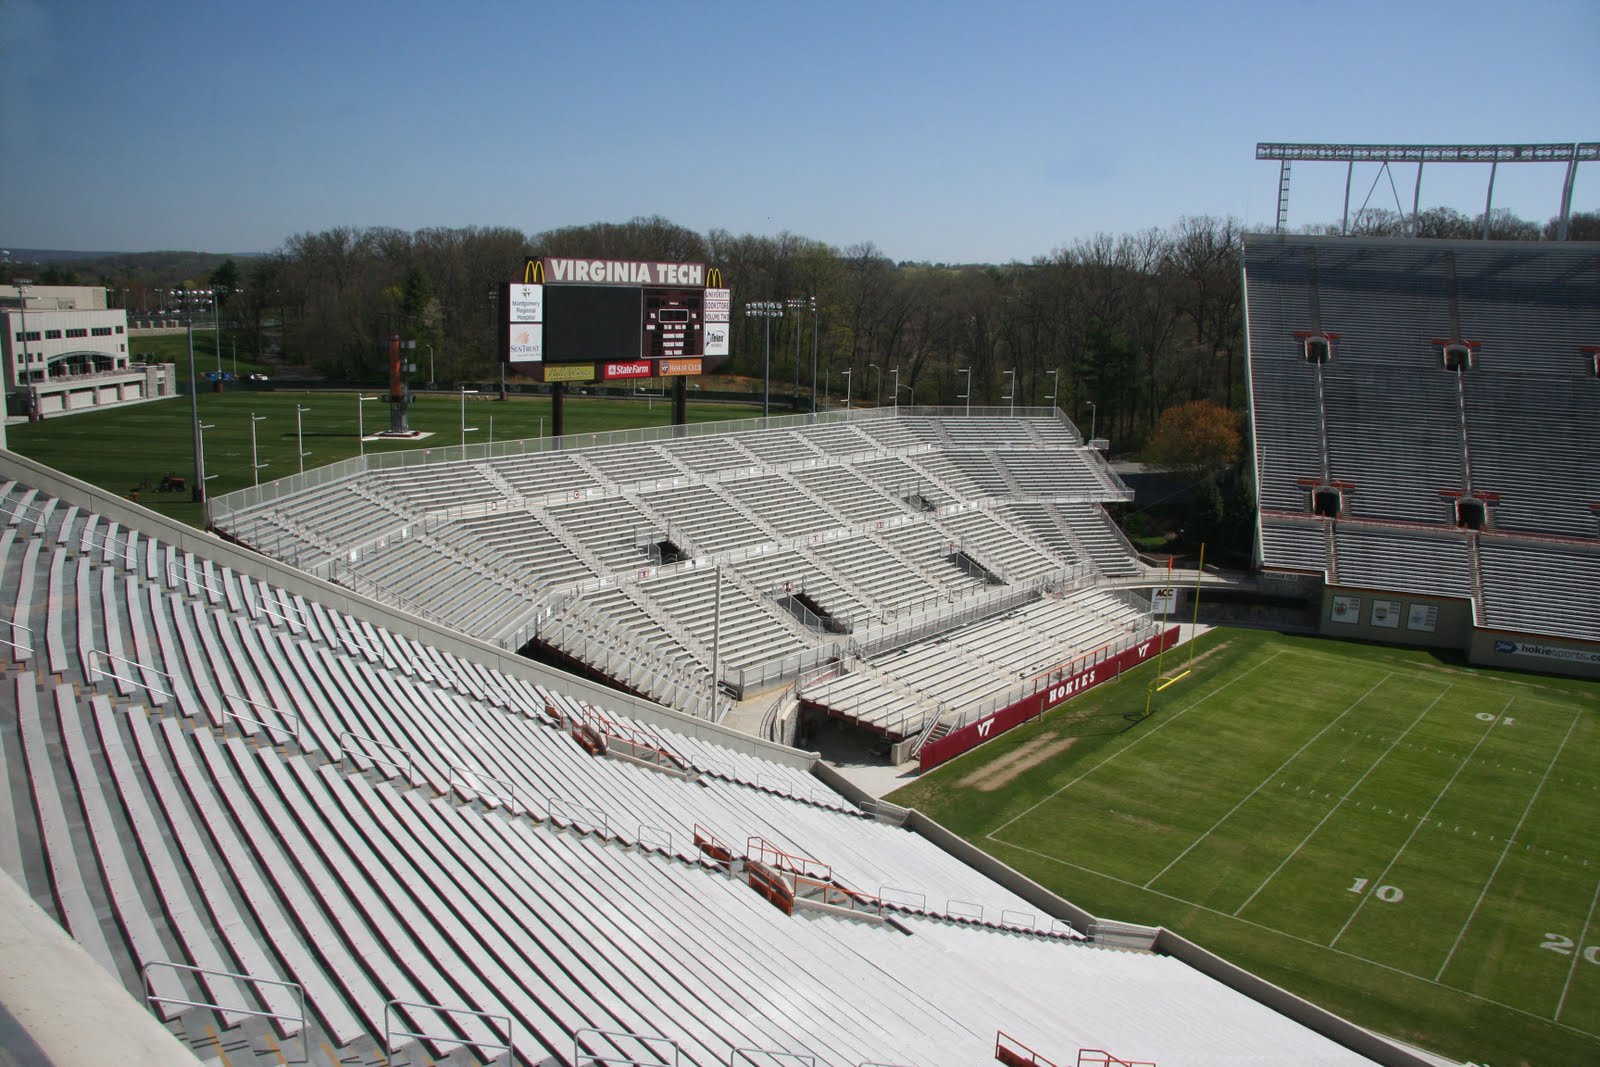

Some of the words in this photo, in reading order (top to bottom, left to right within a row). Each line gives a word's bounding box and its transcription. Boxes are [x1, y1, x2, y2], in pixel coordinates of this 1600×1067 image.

[551, 258, 652, 283] VIRGINIA
[656, 263, 702, 285] TECH
[512, 300, 540, 308] Montgomery
[705, 301, 730, 310] BOOKSTORE
[516, 307, 536, 315] Regional
[1155, 588, 1174, 598] ACC
[1138, 643, 1150, 658] VT
[1049, 670, 1096, 703] HOKIES
[977, 718, 996, 738] VT
